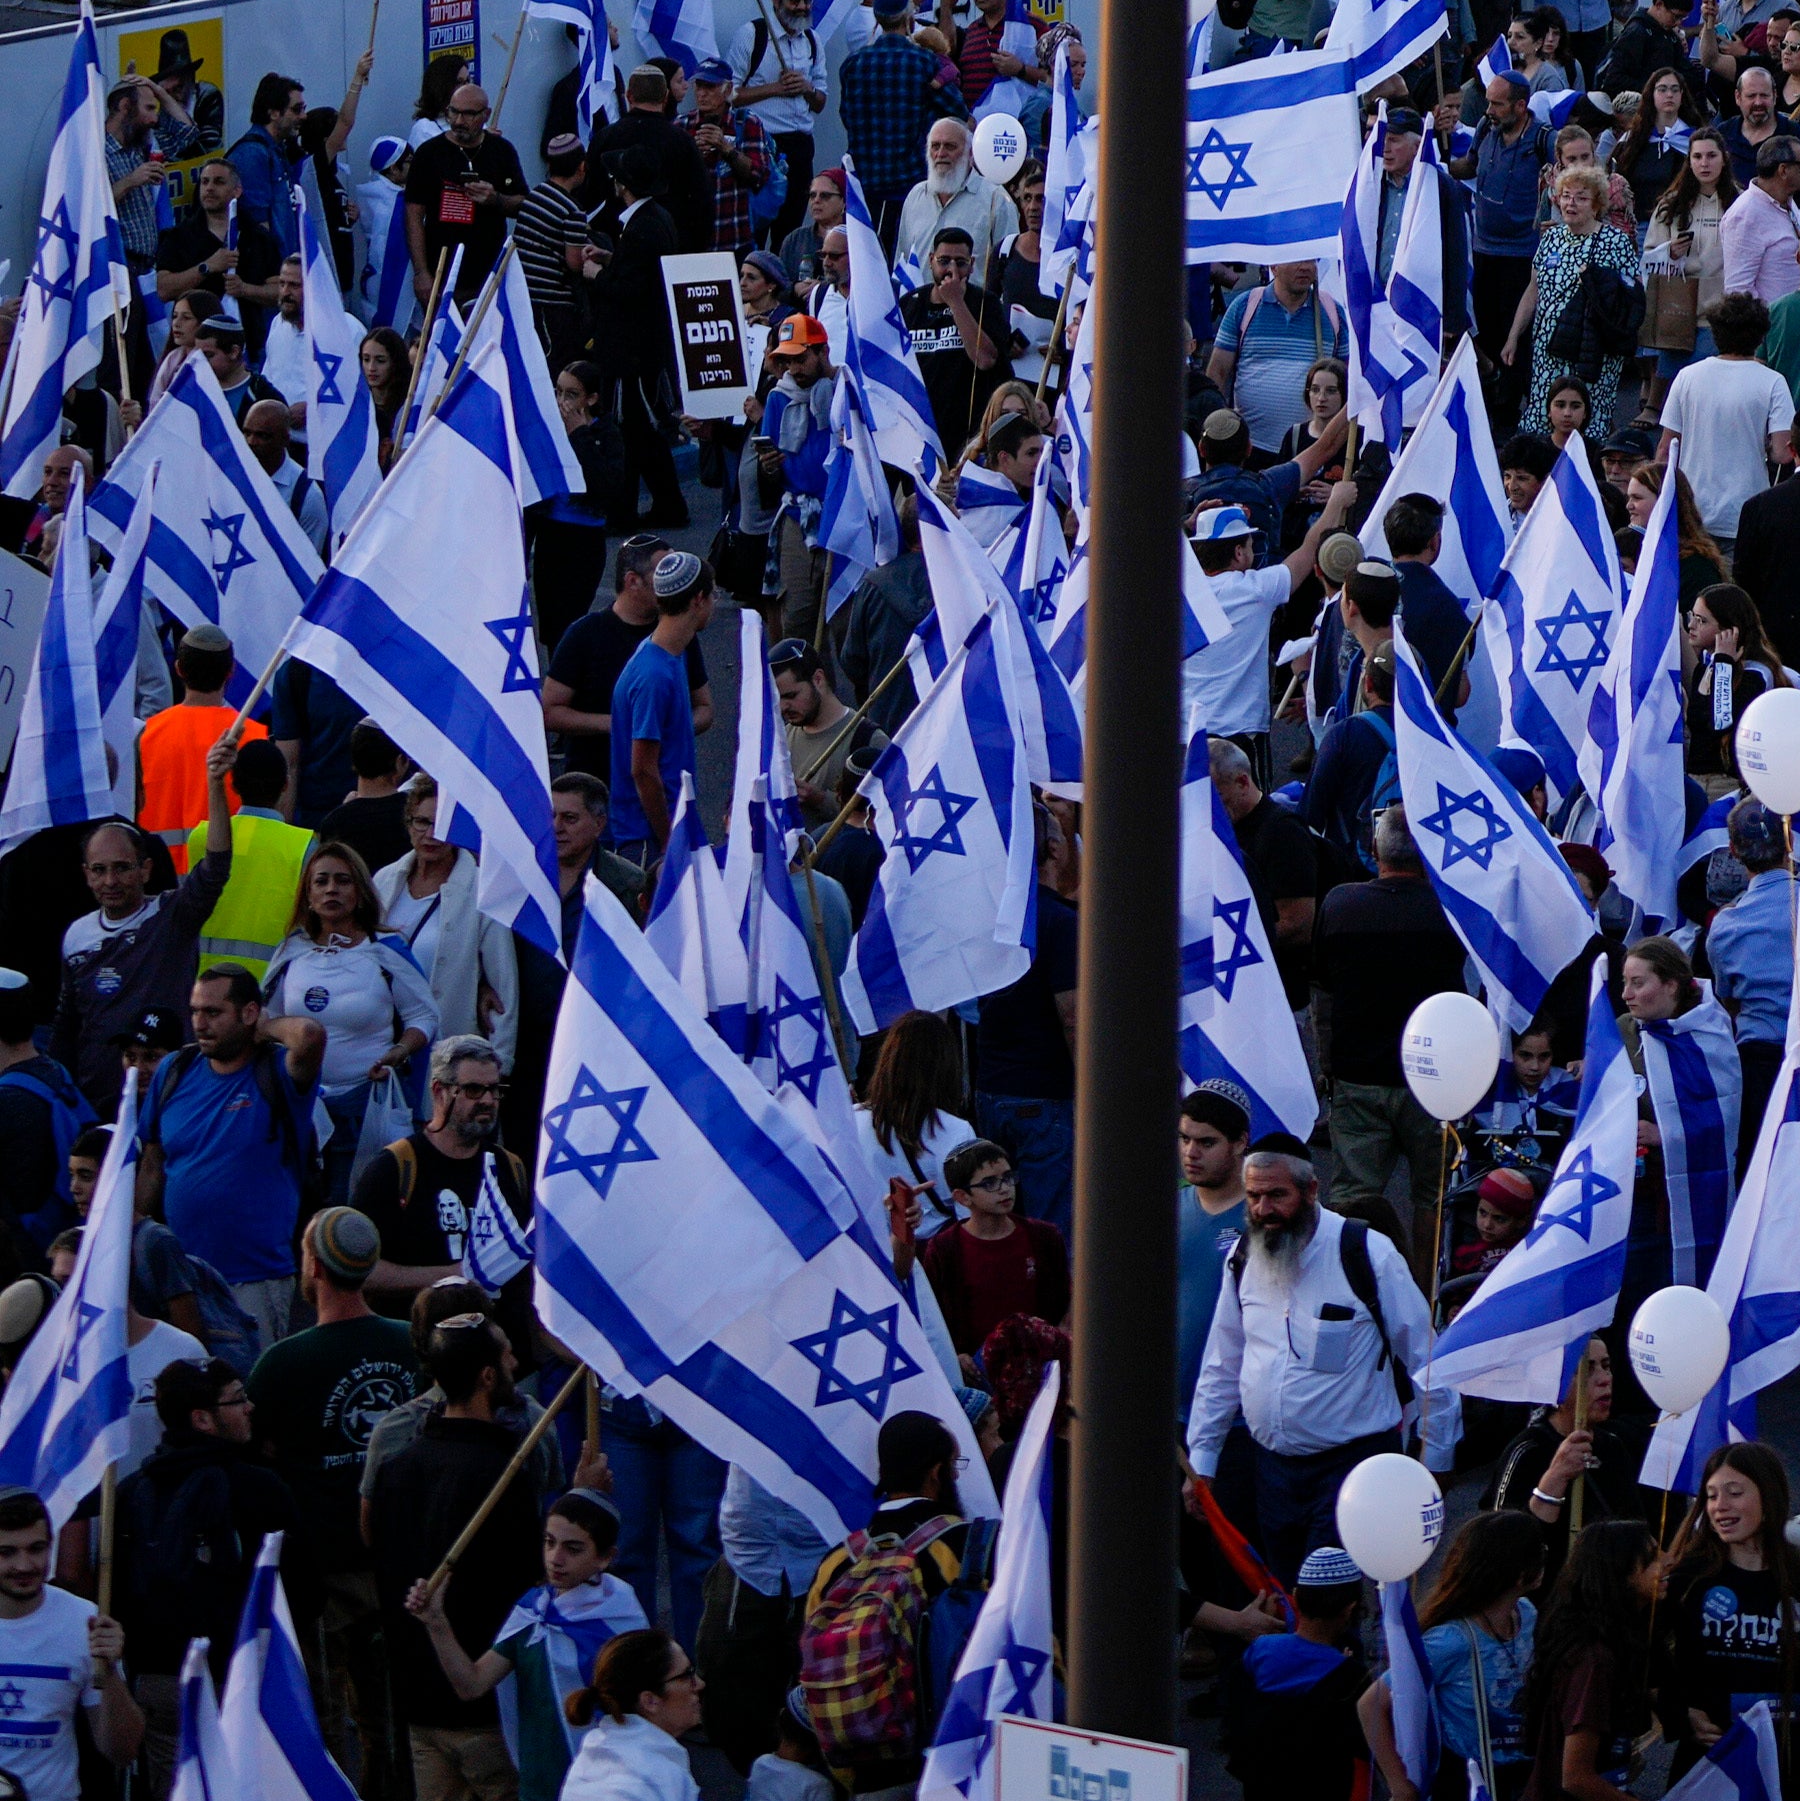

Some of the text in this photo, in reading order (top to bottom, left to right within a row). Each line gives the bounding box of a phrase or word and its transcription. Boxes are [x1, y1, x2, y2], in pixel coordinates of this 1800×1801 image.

[461, 0, 472, 18] את
[993, 146, 1018, 154] יהודית
[686, 285, 719, 298] הכנסת
[698, 303, 714, 313] היא
[685, 319, 735, 344] העם
[908, 328, 937, 340] בחר
[706, 354, 722, 364] הוא
[699, 369, 733, 385] הריבון
